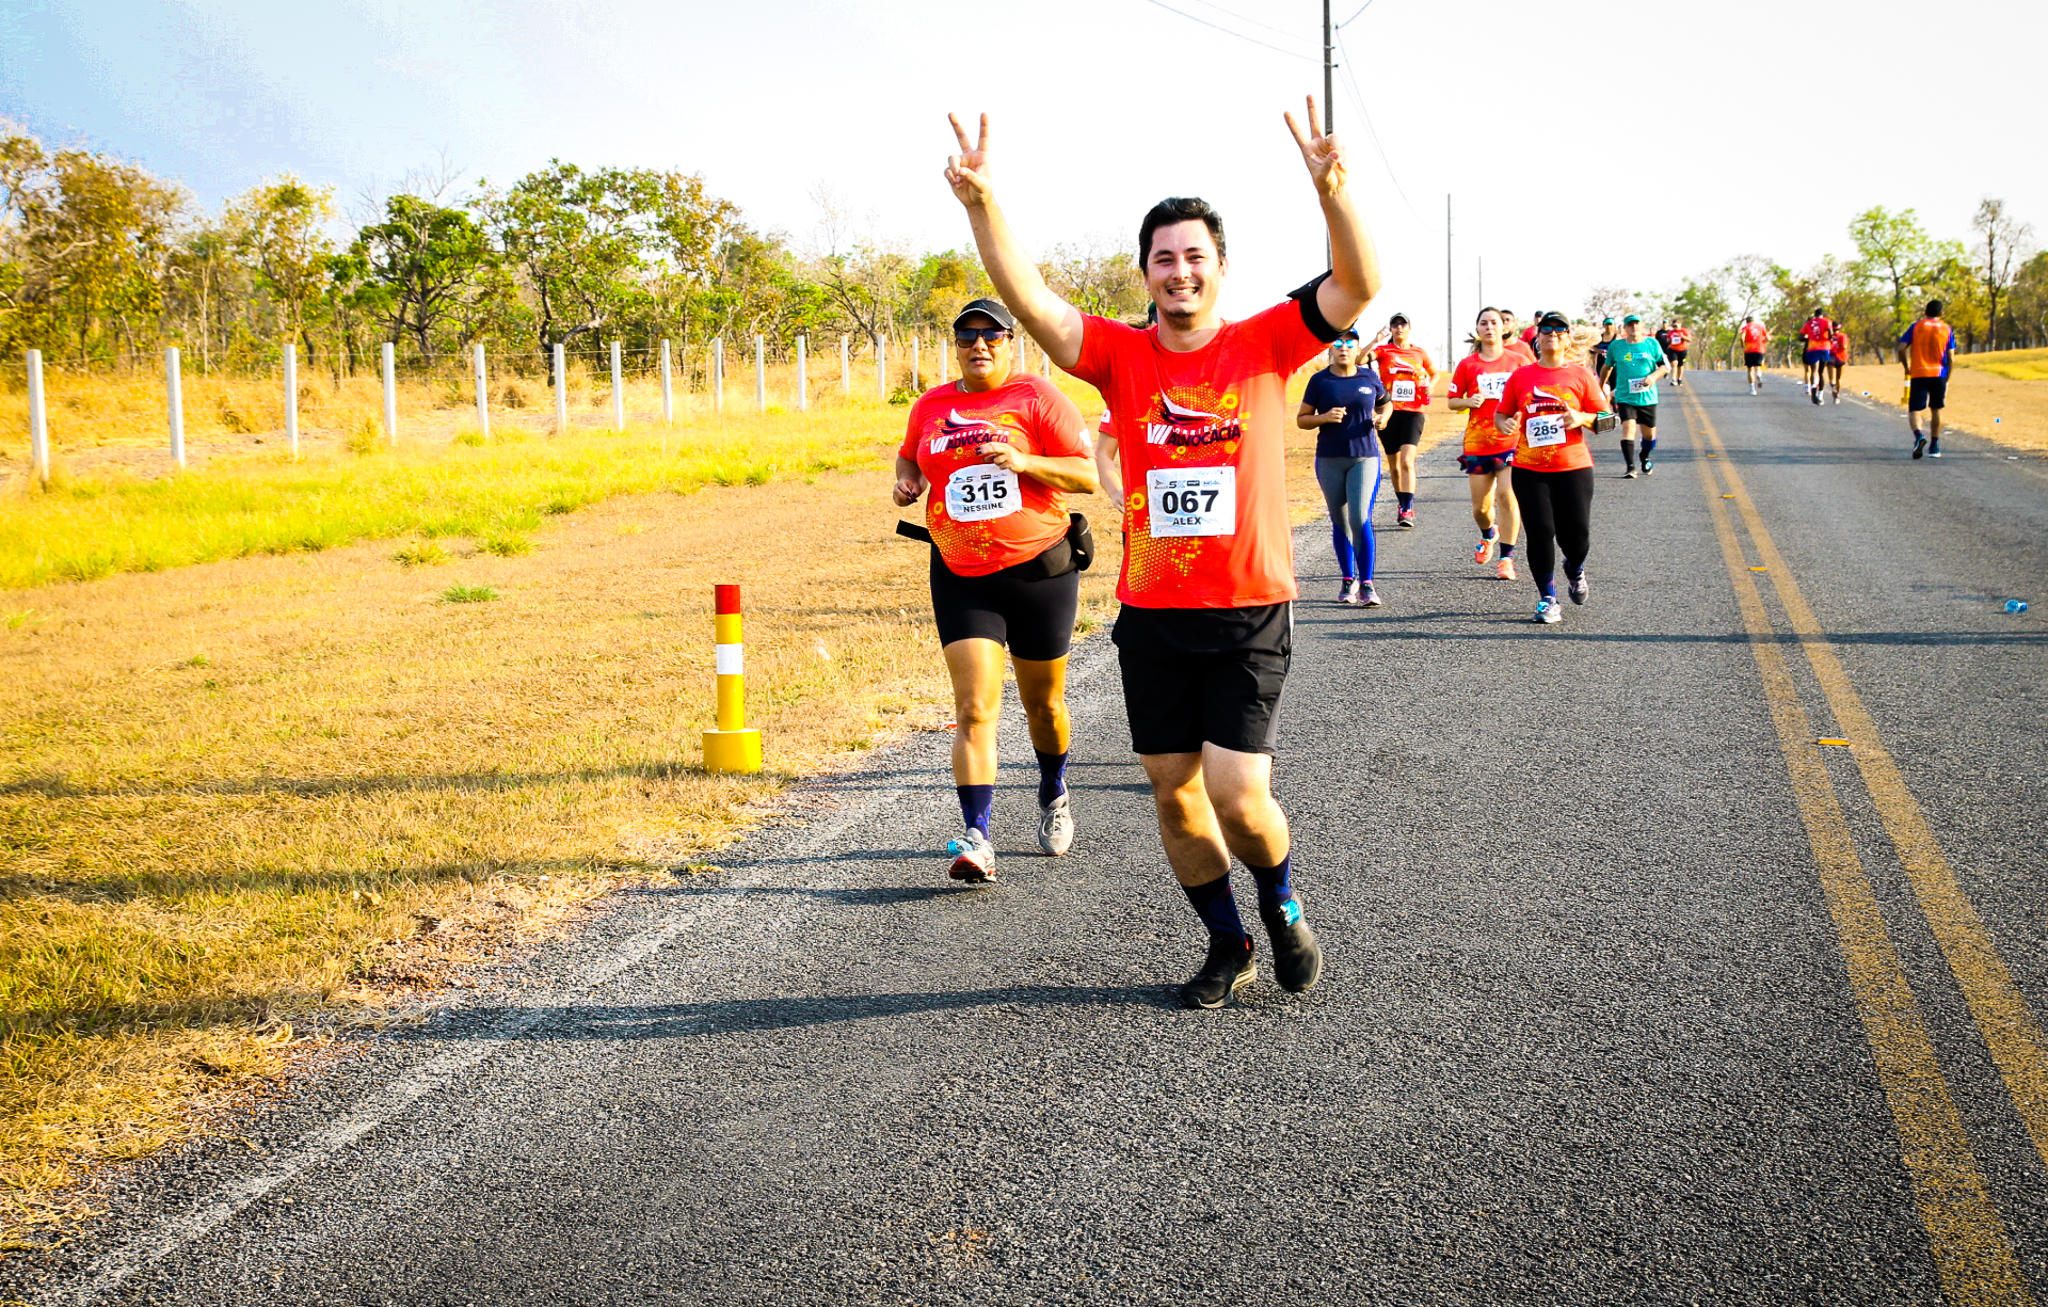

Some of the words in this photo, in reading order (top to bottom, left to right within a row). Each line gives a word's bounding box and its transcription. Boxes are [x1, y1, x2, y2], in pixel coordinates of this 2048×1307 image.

[1167, 425, 1241, 447] ADVOCACIA
[1533, 424, 1558, 437] 285
[946, 433, 1008, 450] ADVOCACIA
[961, 480, 1008, 503] 315
[963, 502, 1004, 513] NESRINE
[1162, 489, 1219, 514] 067
[1172, 517, 1202, 526] ALEX
